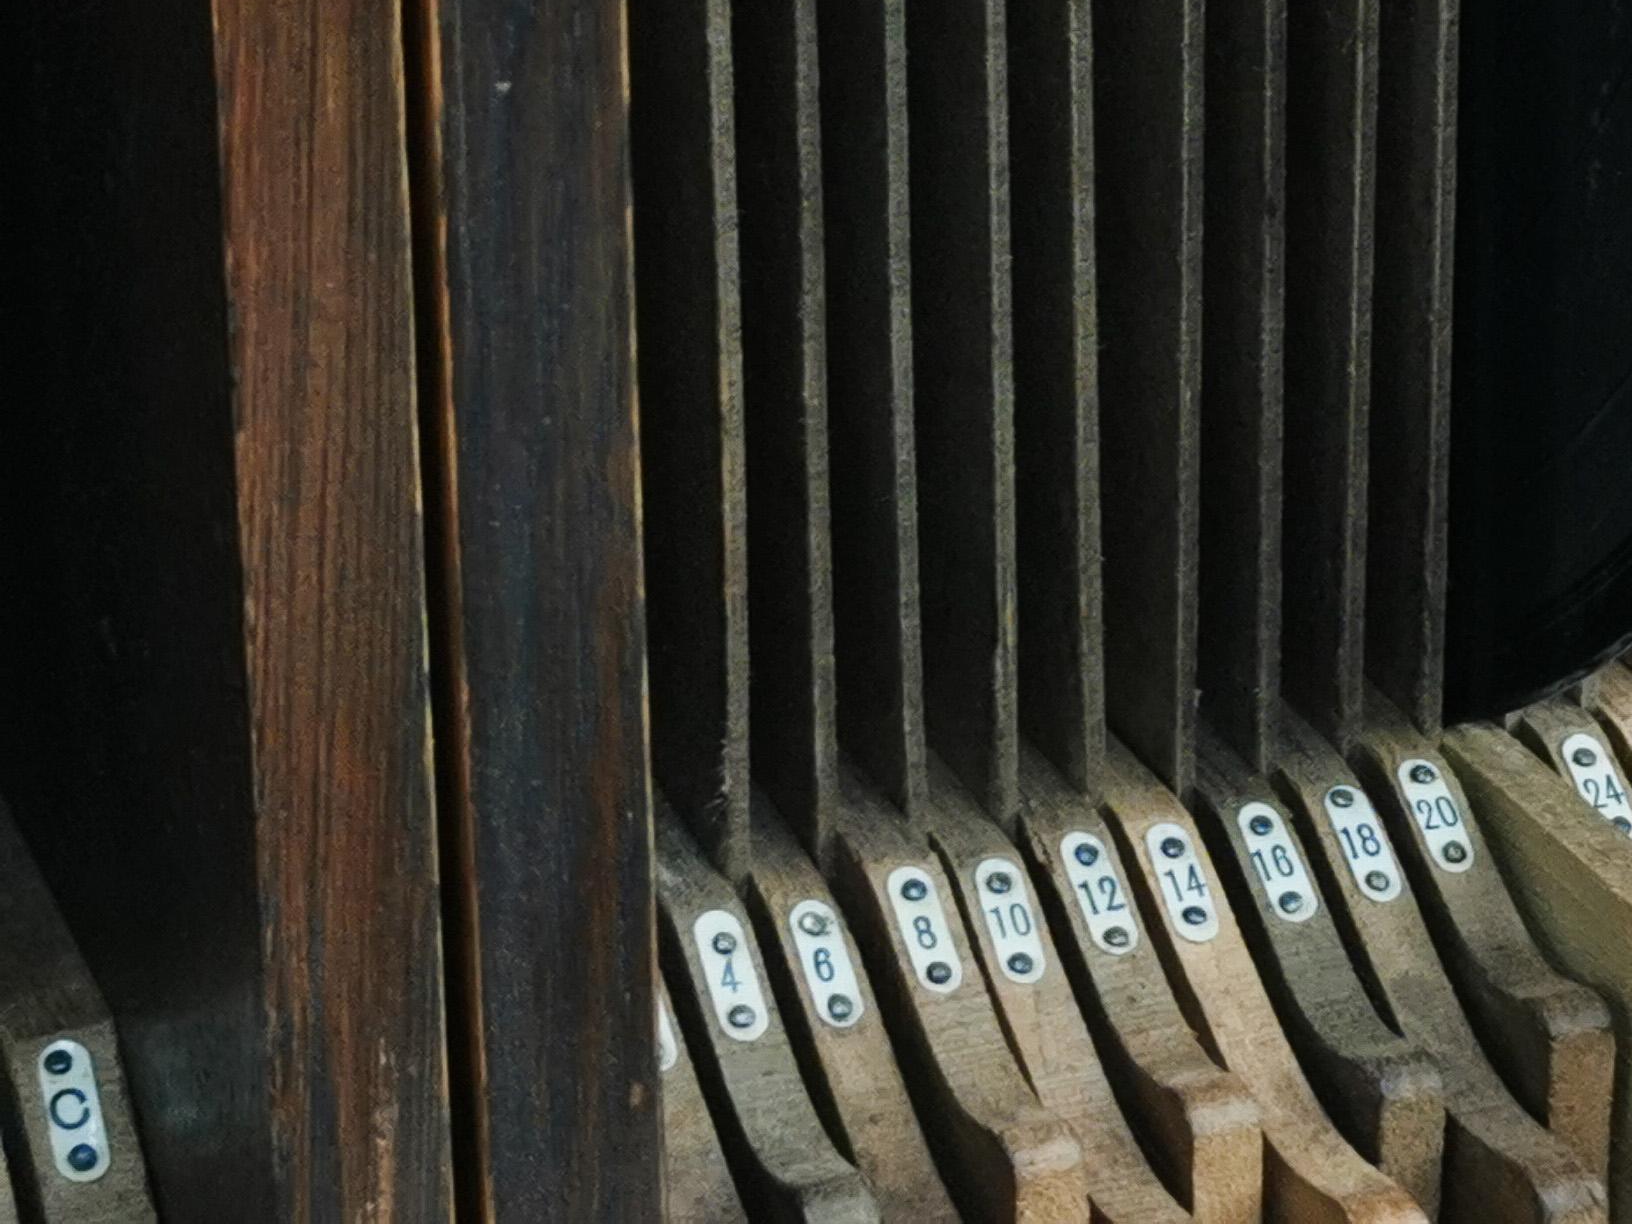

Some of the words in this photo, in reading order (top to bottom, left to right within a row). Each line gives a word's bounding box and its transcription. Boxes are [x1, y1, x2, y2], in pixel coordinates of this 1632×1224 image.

[1583, 774, 1624, 809] 24
[1416, 796, 1458, 830] 20
[1340, 823, 1381, 860] 18
[1250, 844, 1295, 882] 16
[1078, 876, 1126, 915] 12
[1163, 863, 1206, 902] 14
[912, 916, 937, 949] 8
[989, 902, 1031, 939] 10
[721, 954, 742, 993] 4
[813, 947, 835, 982] 6
[51, 1088, 90, 1130] C
